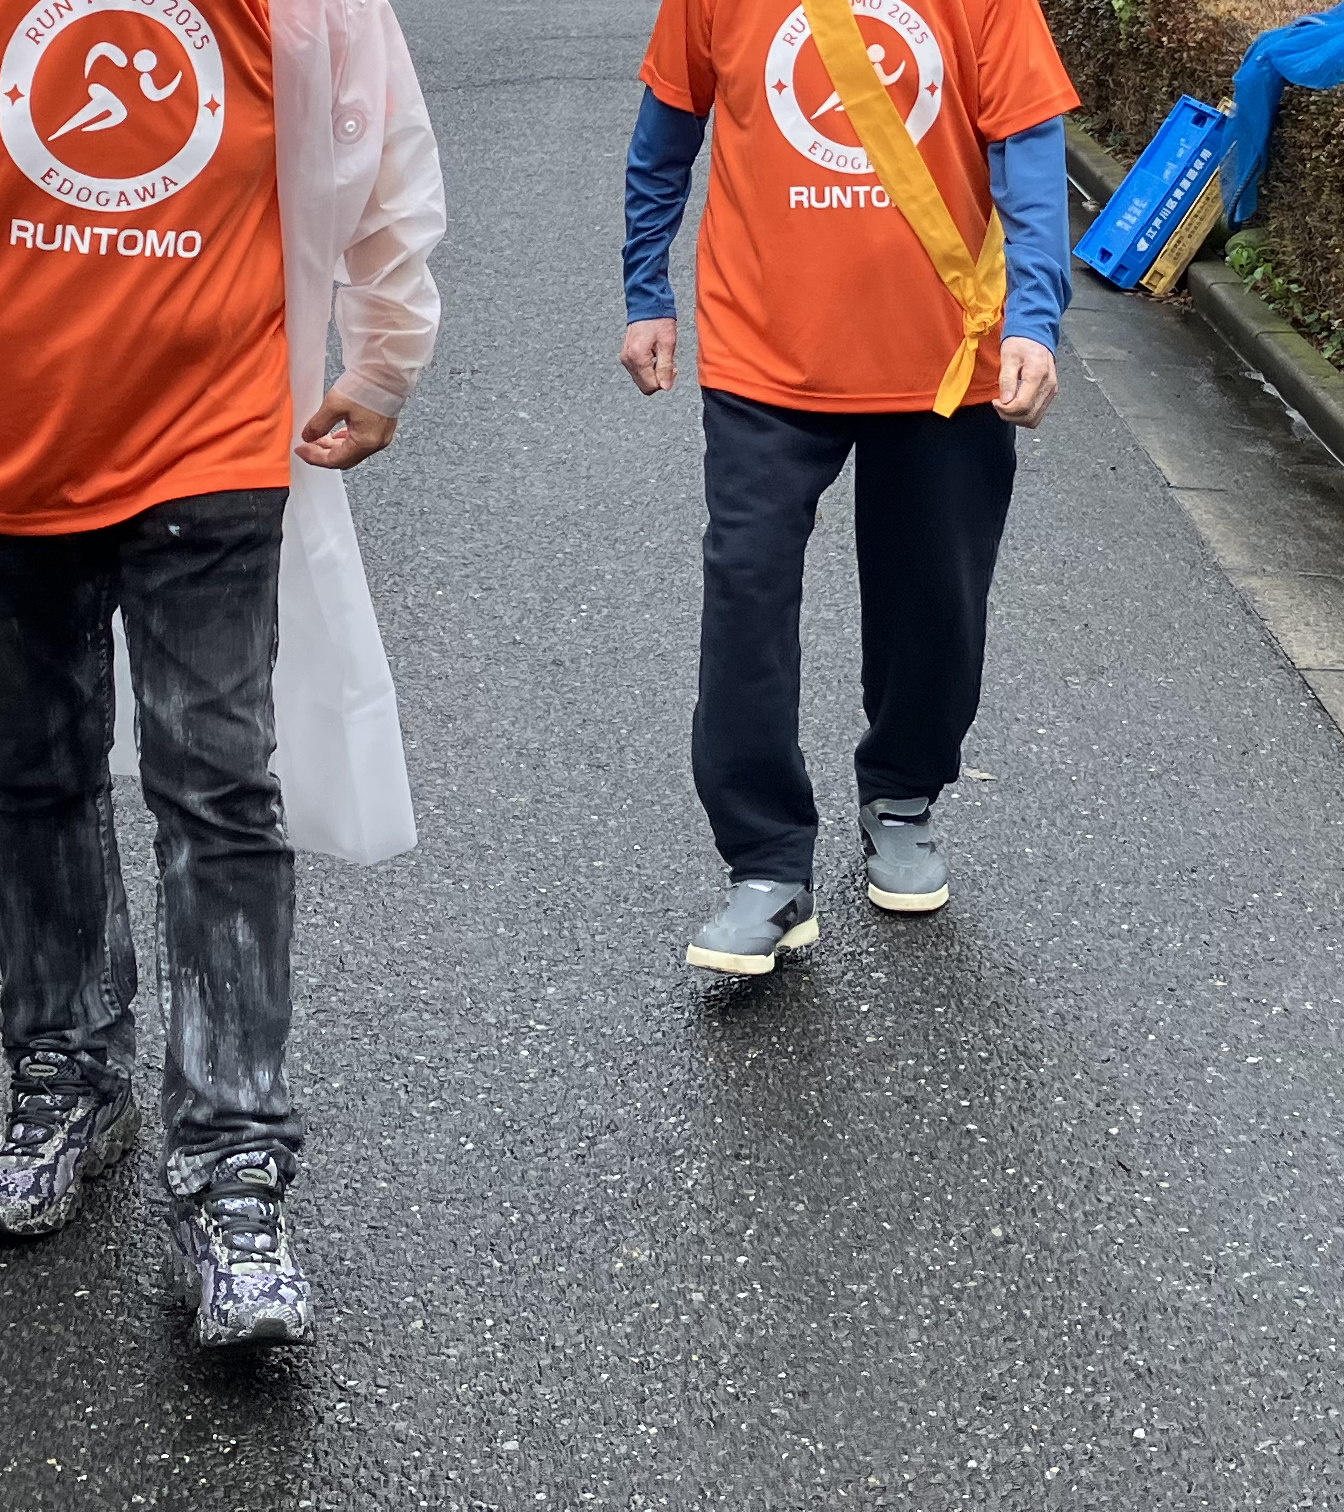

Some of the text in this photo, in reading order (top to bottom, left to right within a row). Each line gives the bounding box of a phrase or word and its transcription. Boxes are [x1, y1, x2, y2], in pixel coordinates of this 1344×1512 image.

[782, 11, 807, 47] RU
[887, 3, 929, 45] 2025
[807, 140, 871, 170] EDOG
[40, 167, 178, 207] EDOGAWA
[789, 185, 895, 209] RUNTO
[10, 218, 202, 258] RUNTOMO
